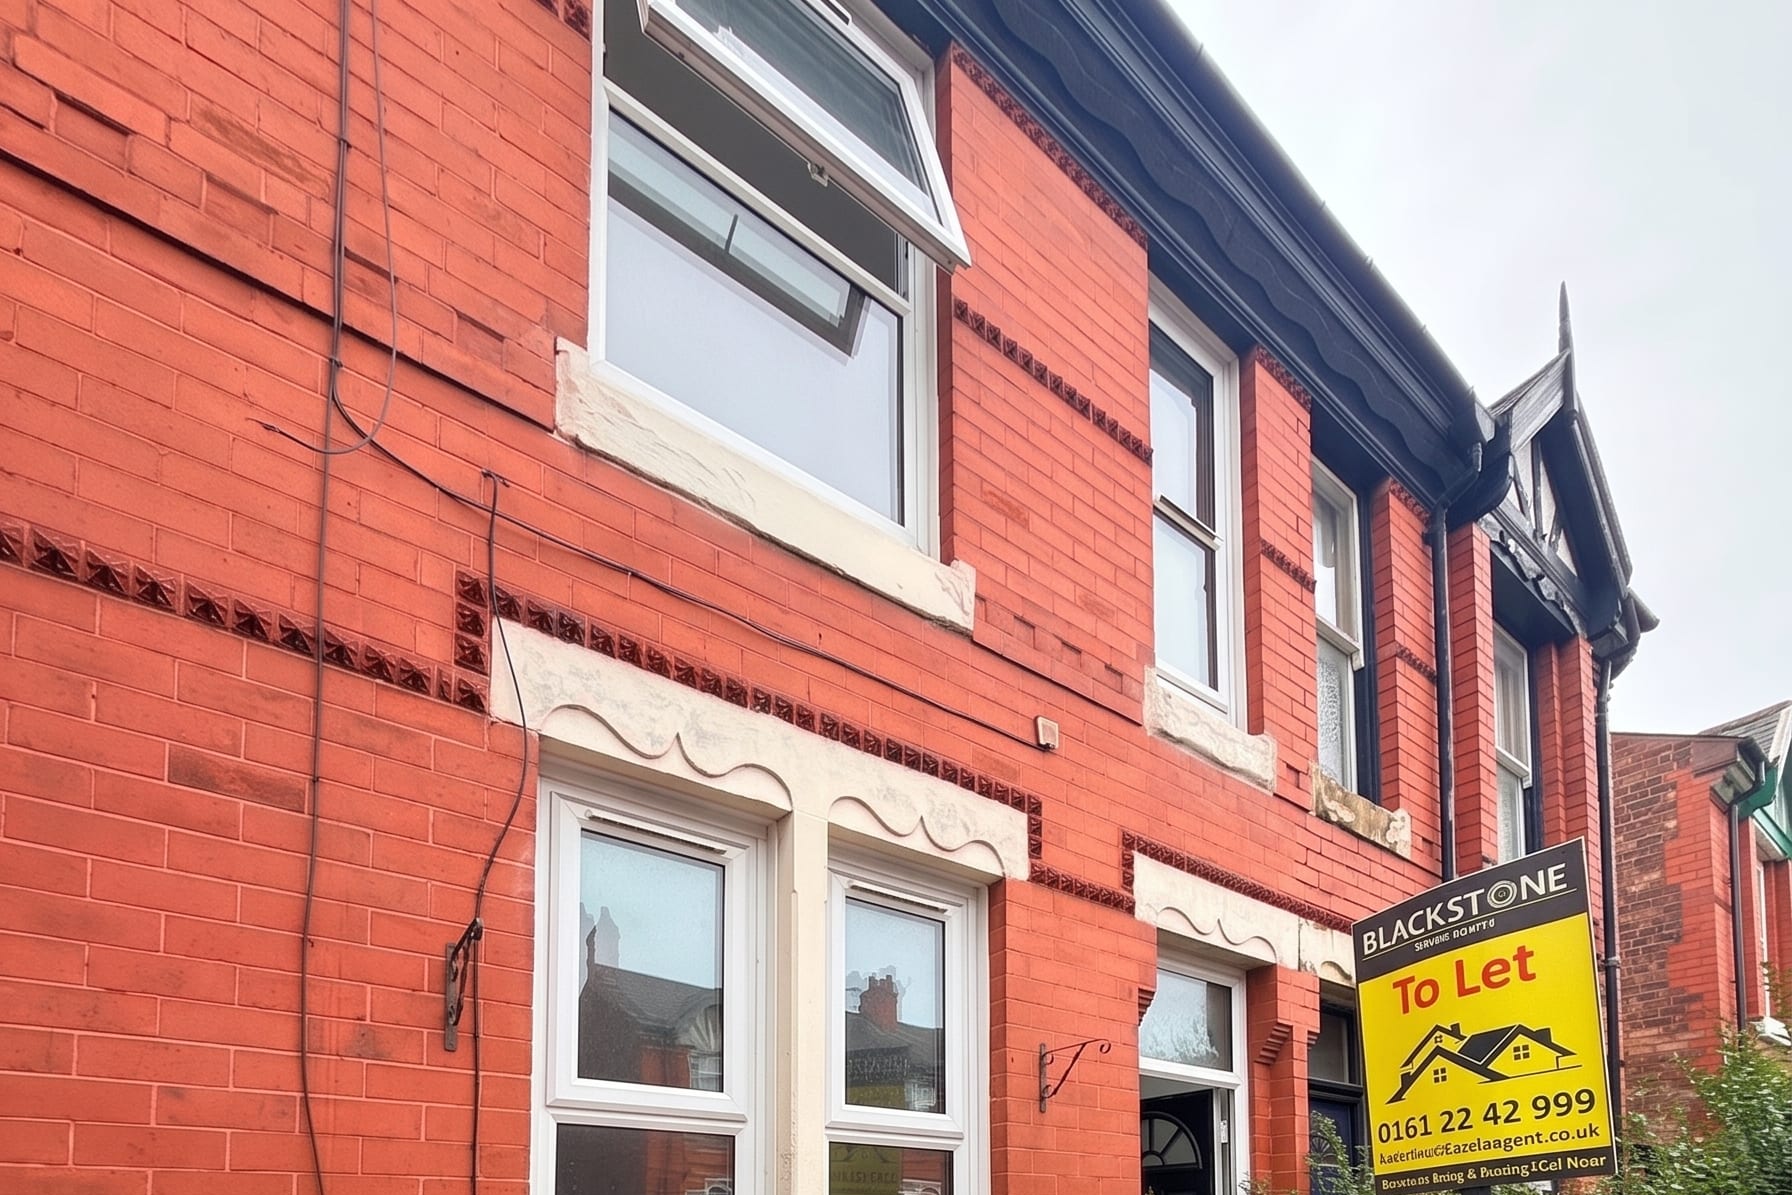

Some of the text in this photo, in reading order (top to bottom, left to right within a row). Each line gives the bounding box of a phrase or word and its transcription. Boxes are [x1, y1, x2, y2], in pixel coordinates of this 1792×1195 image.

[1362, 862, 1568, 956] BLACKSTONE
[1392, 945, 1537, 1015] To Let
[1378, 1088, 1596, 1144] 0161 22 42 999
[1466, 1168, 1477, 1180] &
